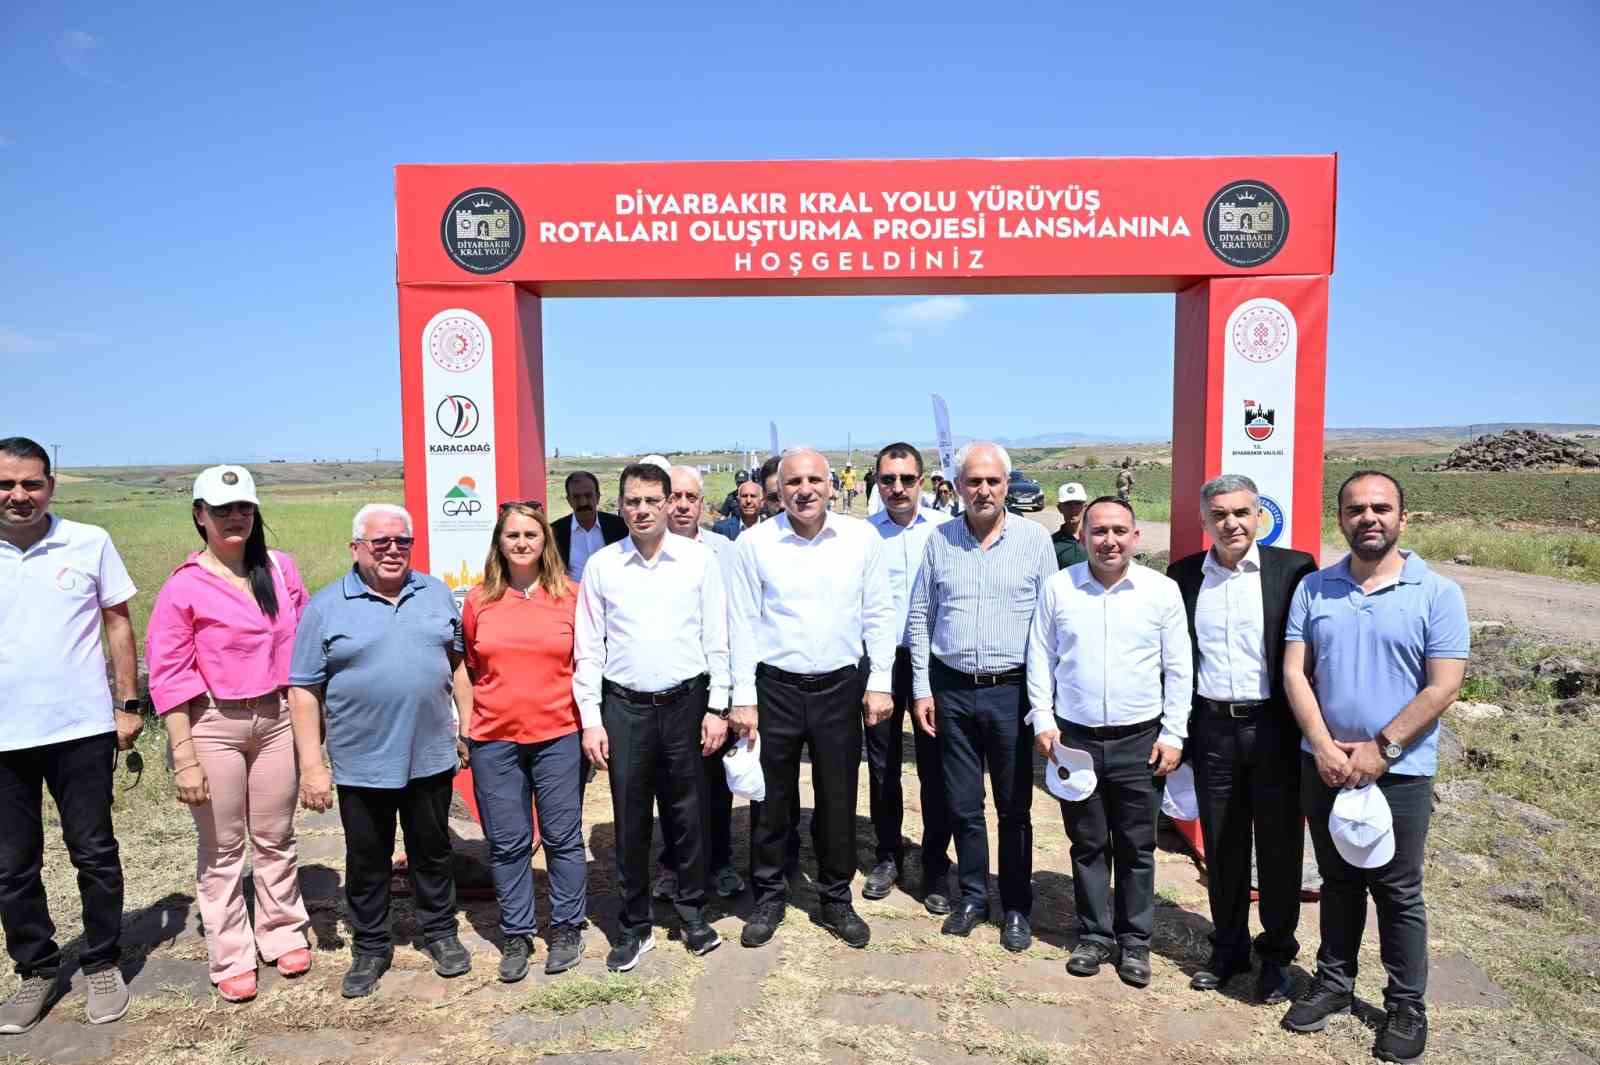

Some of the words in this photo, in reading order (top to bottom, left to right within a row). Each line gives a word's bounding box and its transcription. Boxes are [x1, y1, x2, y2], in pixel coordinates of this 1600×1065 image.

[615, 188, 787, 215] DİYARBAKIR
[799, 191, 874, 214] KRAL
[881, 190, 957, 213] YOLU
[967, 184, 1101, 217] YÜRÜYÜŞ
[540, 220, 678, 243] ROTALARI
[689, 219, 863, 247] OLUŞTURMA
[873, 212, 985, 240] PROJESİ
[998, 215, 1191, 239] LANSMANINA
[1219, 233, 1273, 242] DİYARBAKIR
[457, 239, 511, 249] DİYARBAKIR
[1222, 241, 1246, 249] KRAL
[1246, 241, 1270, 249] YOLU
[460, 248, 483, 256] KRAL
[483, 248, 507, 256] YOLU
[735, 246, 984, 277] HOŞGELDİNİZ
[429, 442, 491, 453] KARACADAĞ
[442, 500, 482, 517] GAP
